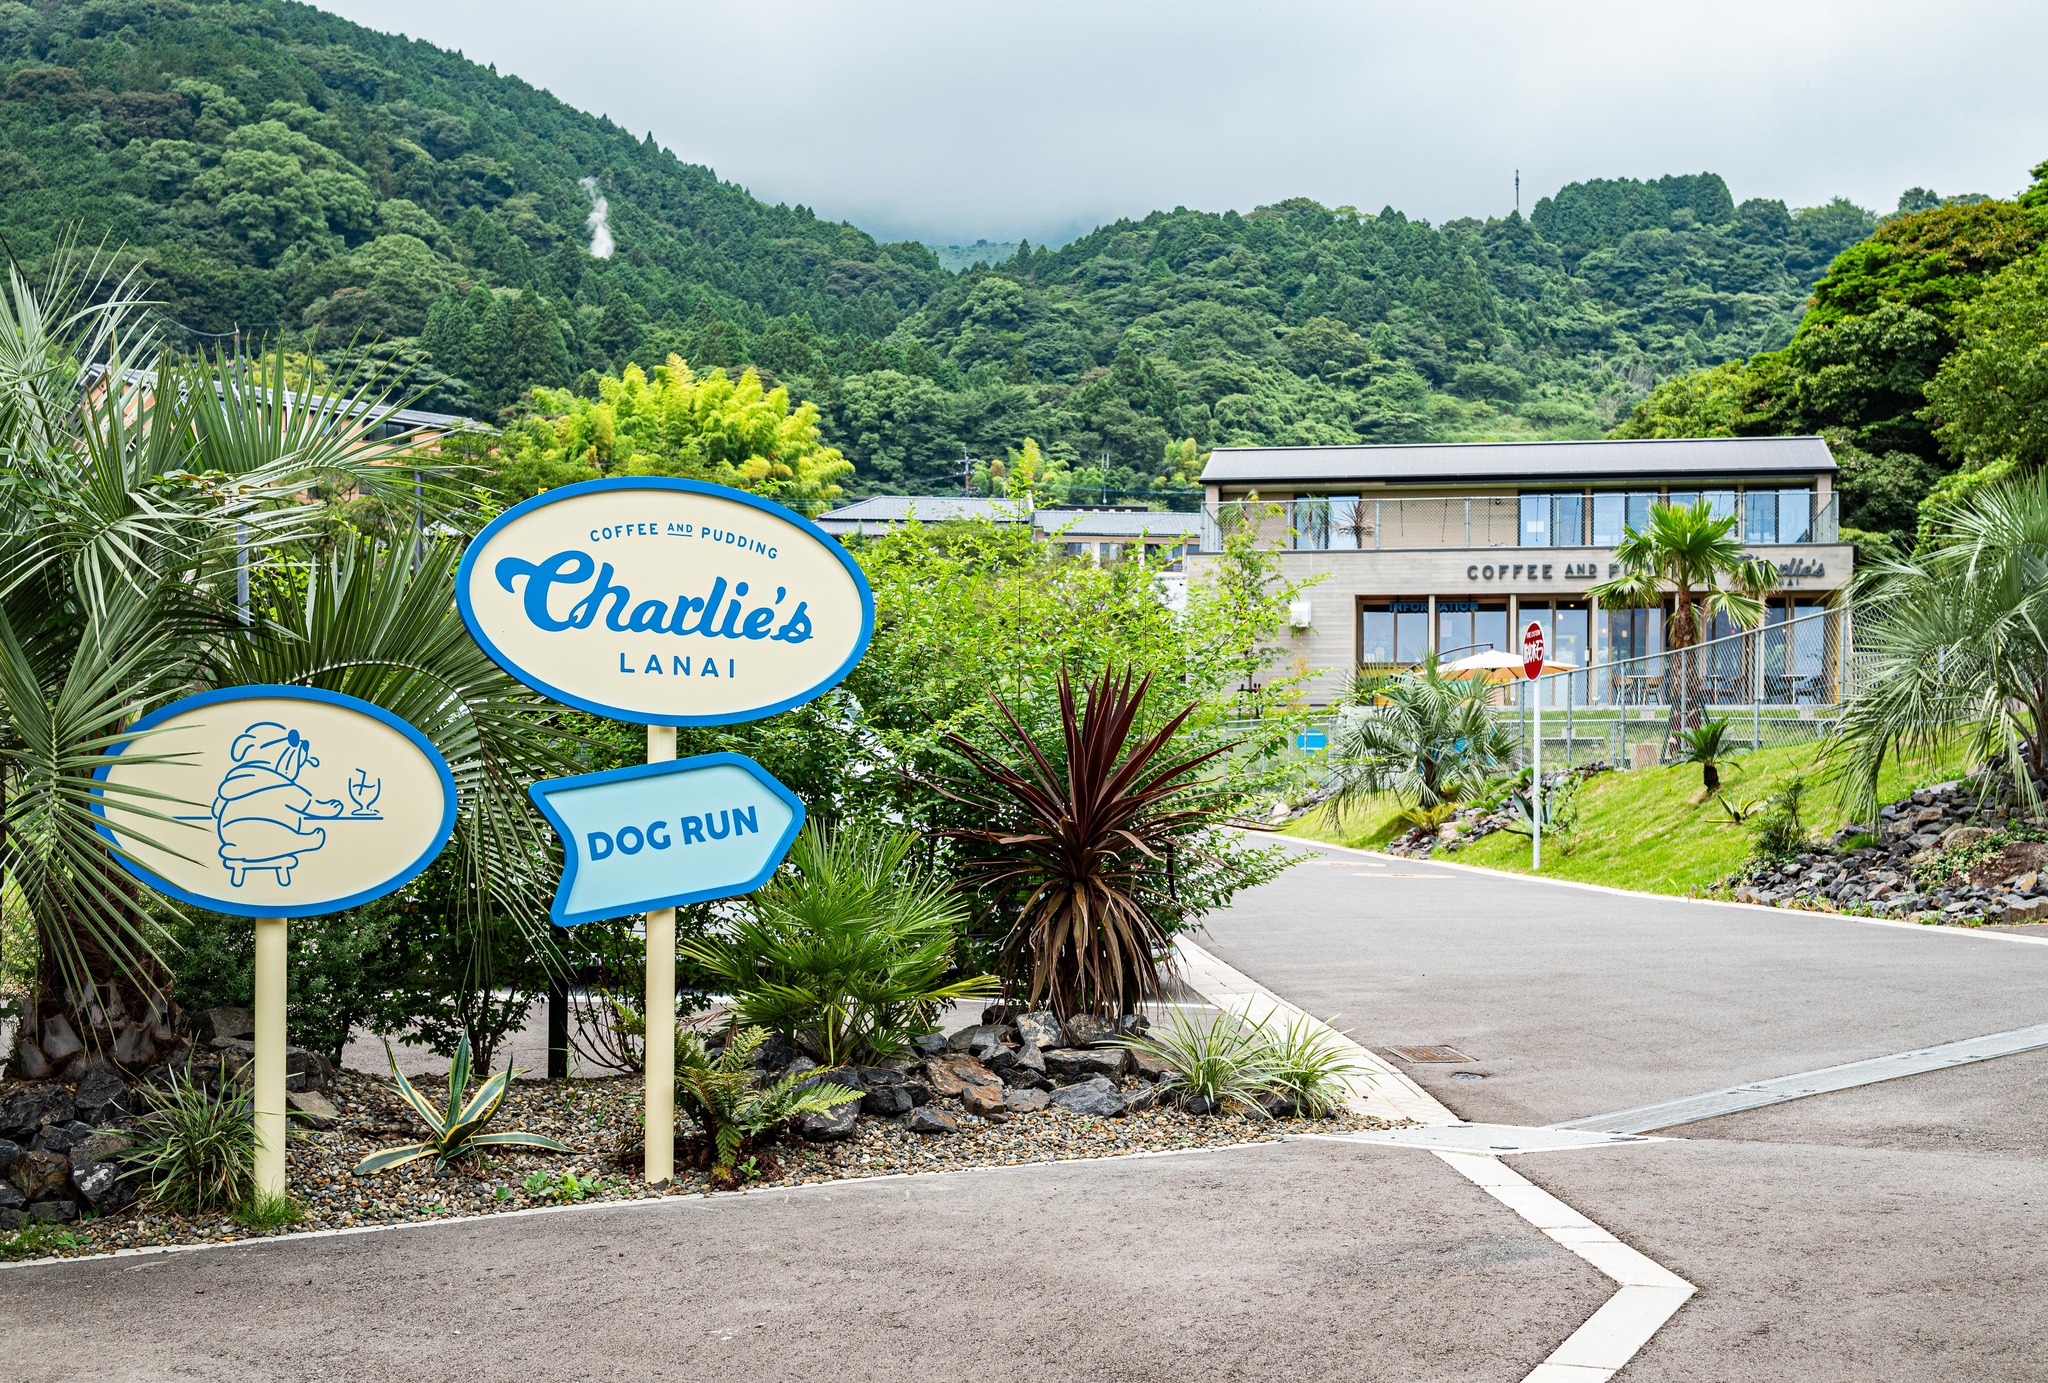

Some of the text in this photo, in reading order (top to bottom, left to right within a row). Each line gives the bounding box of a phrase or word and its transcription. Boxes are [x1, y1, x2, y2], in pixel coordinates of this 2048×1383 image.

[590, 523, 778, 559] COFFEE AND PUDDING
[1467, 564, 1552, 581] COFFEE
[1565, 563, 1597, 577] AND
[494, 550, 814, 645] Charlie's
[1389, 601, 1479, 612] INFORATION
[620, 653, 734, 678] LANAI
[588, 806, 758, 861] DOG RUN
